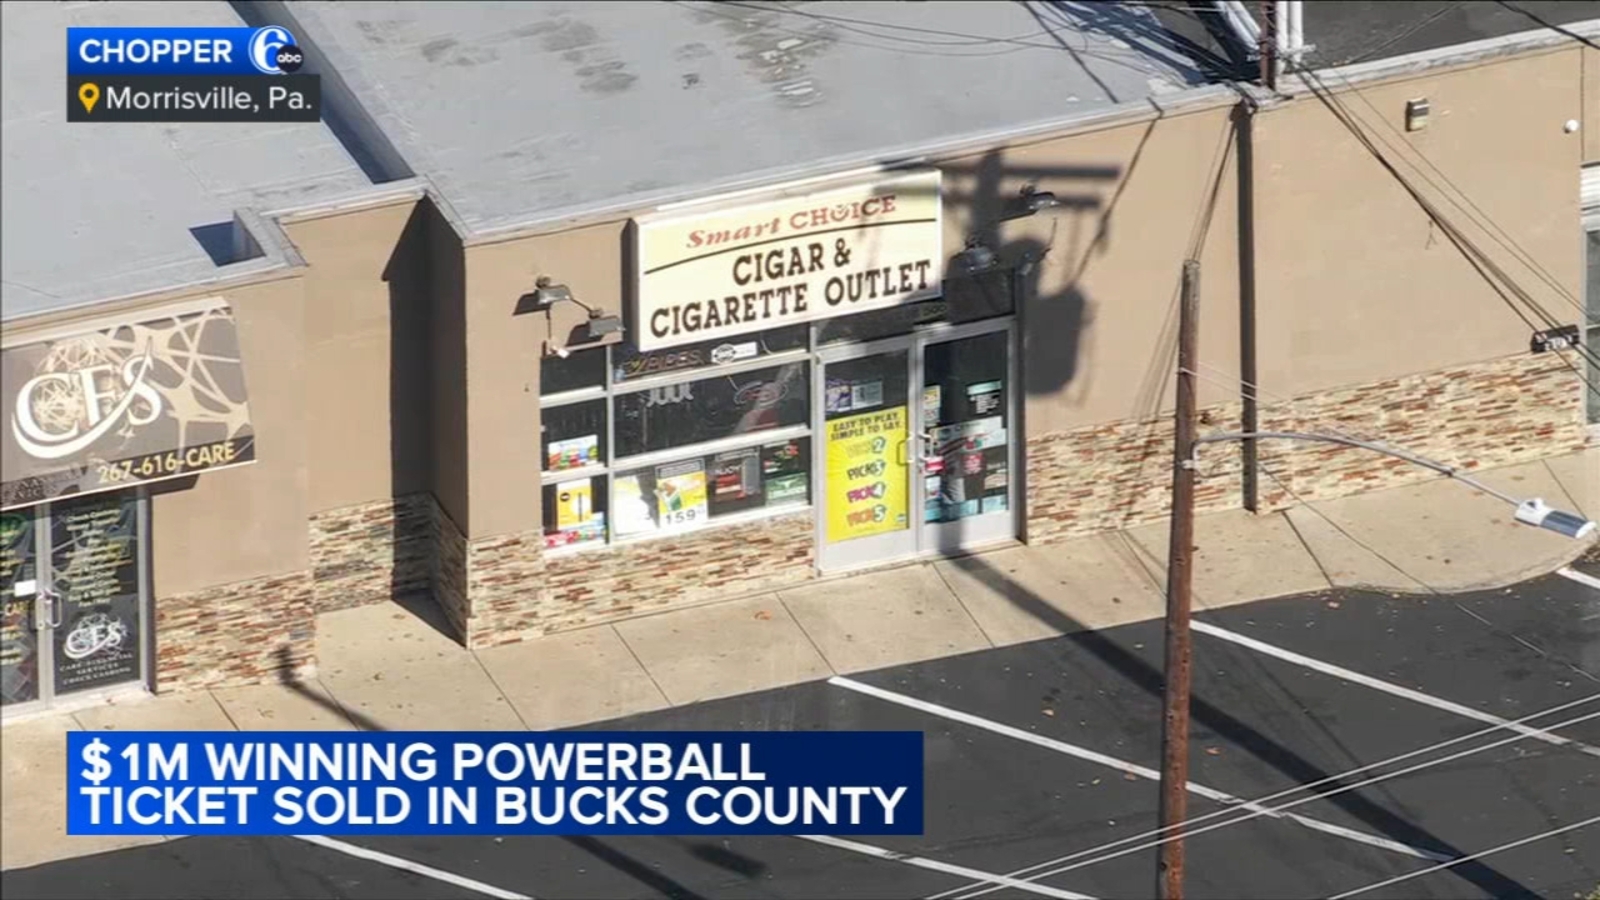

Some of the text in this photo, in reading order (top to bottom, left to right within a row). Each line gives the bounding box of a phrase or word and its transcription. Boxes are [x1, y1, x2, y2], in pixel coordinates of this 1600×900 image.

[686, 195, 896, 248] Smart CHOICE
[732, 238, 852, 286] CIGAR &
[650, 259, 931, 338] CIGARETTE OUTLET
[99, 443, 235, 483] 267-616-CARE
